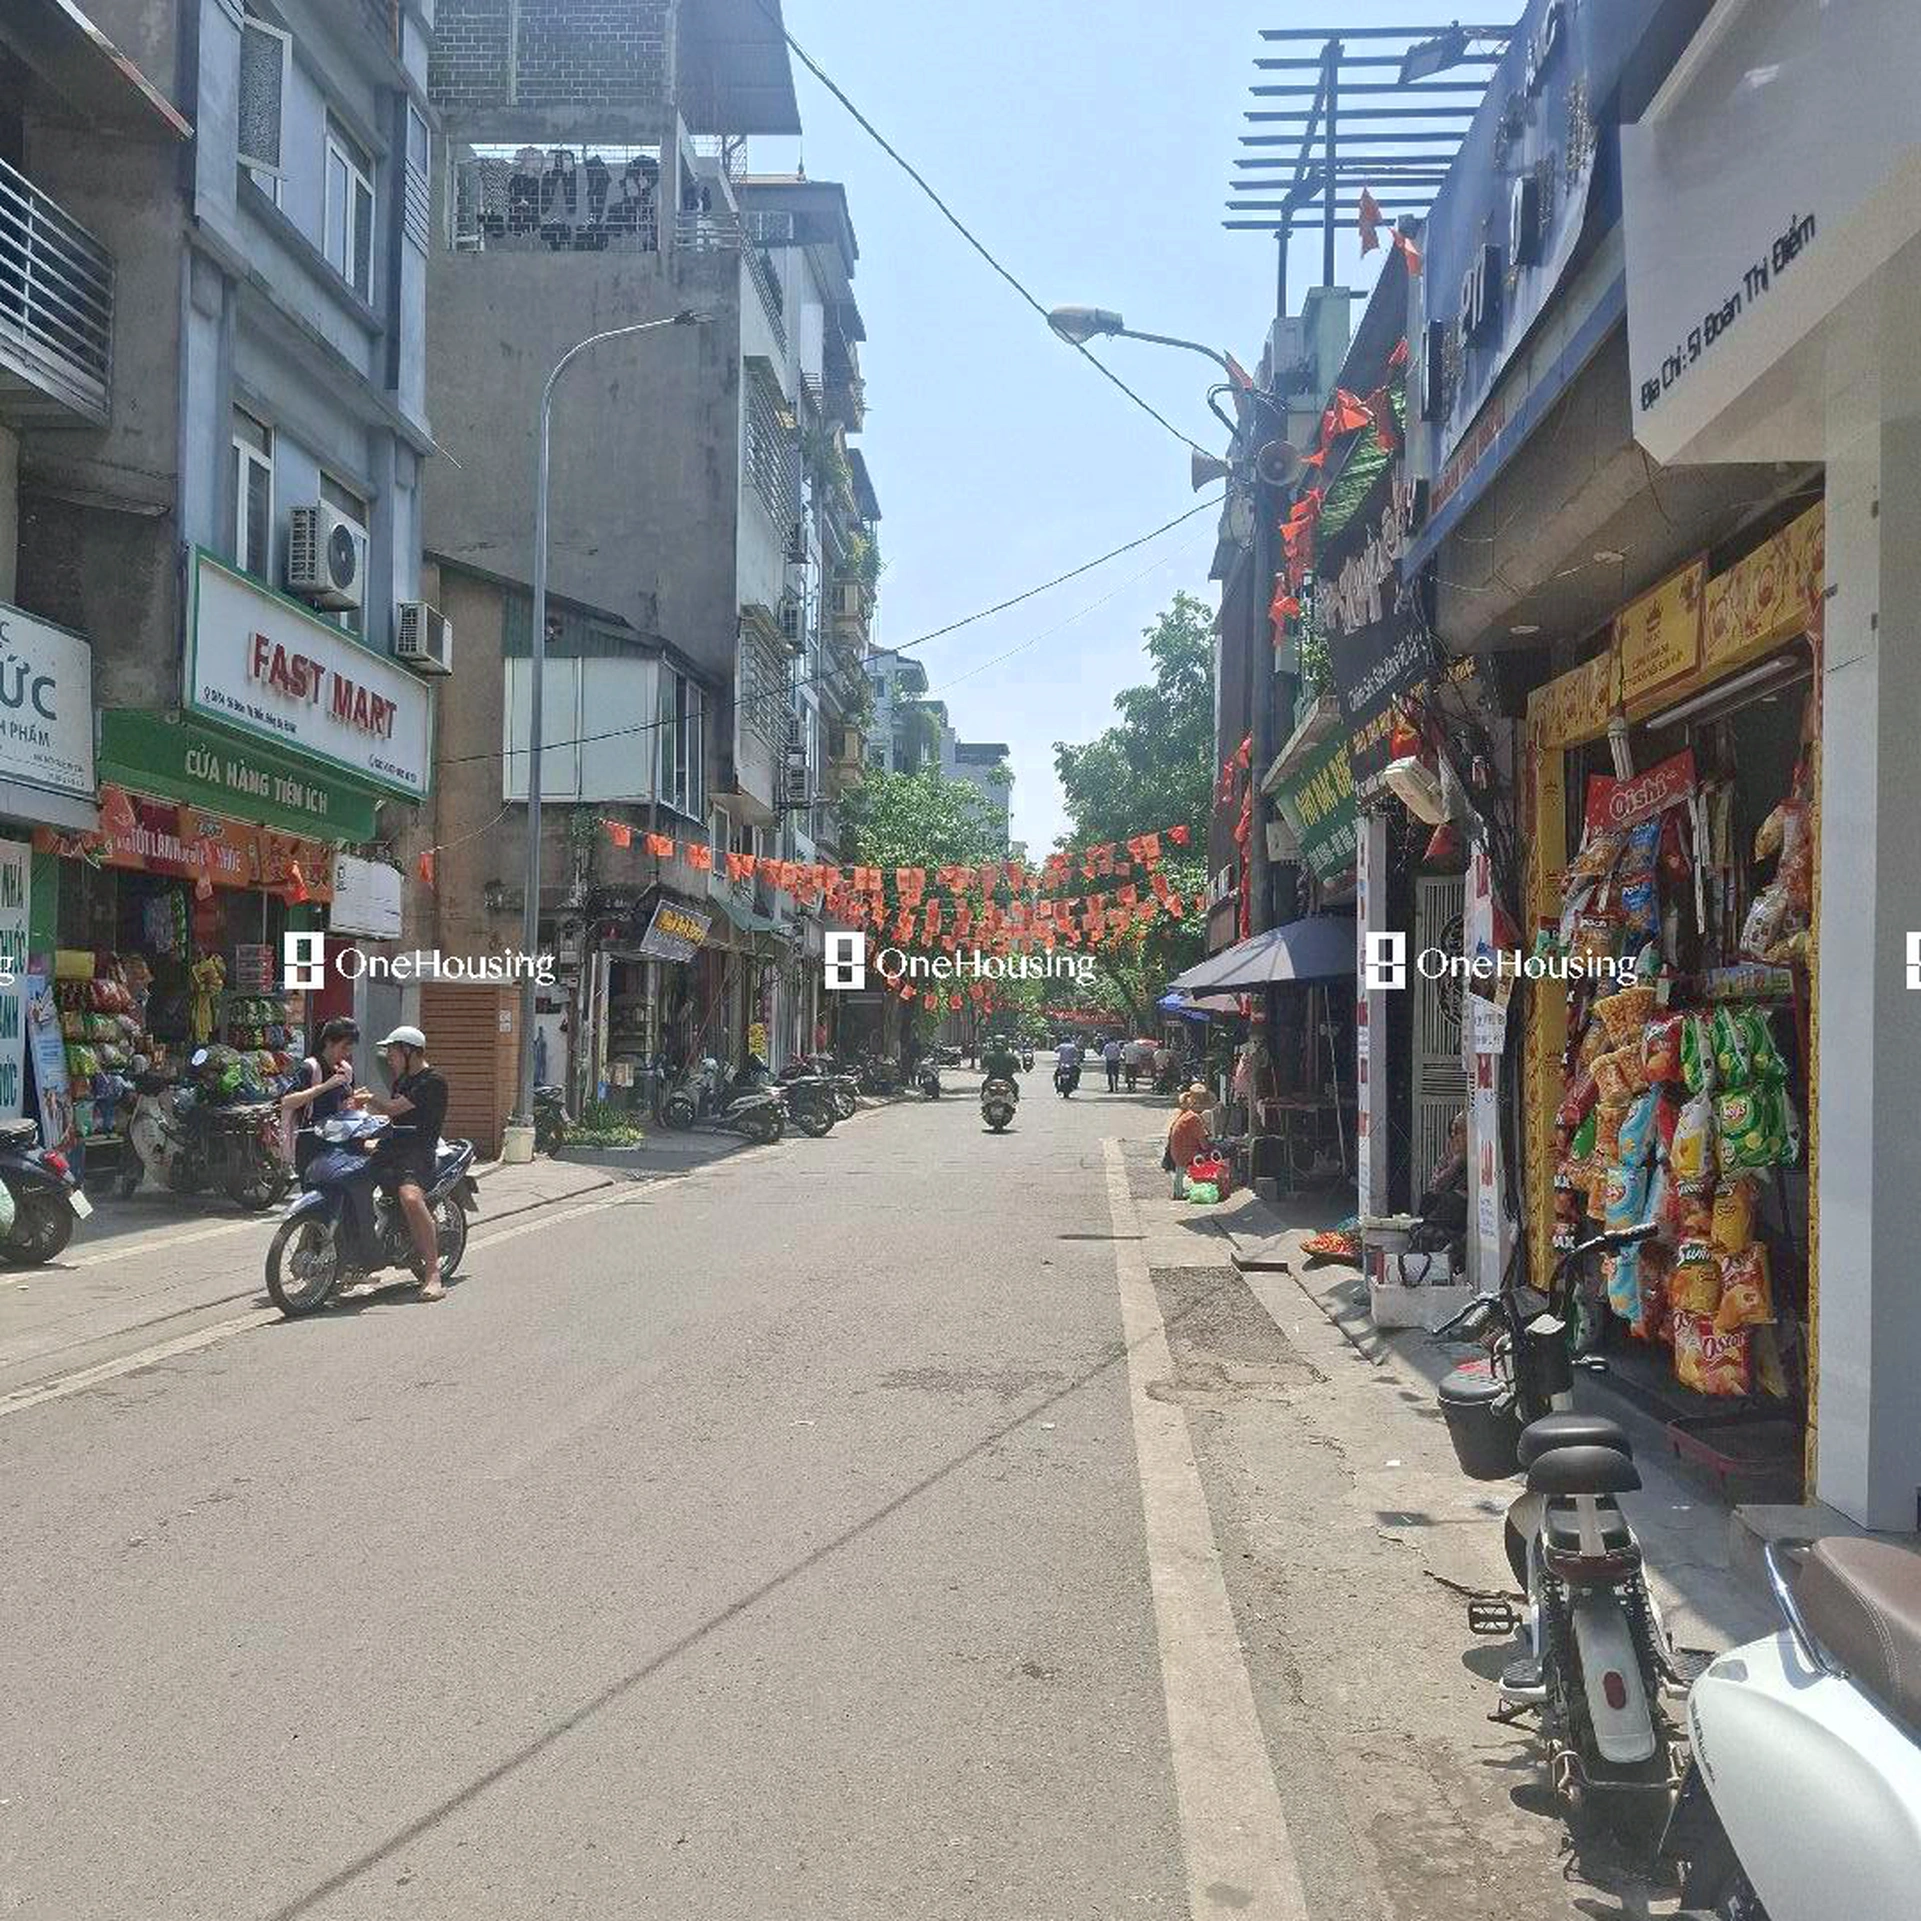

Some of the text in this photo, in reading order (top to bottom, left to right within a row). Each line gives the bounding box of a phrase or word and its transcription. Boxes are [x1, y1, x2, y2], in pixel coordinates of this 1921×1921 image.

[1641, 378, 1660, 411] Địa
[1703, 292, 1742, 346] Đoàn
[1743, 256, 1769, 302] Thị
[1771, 213, 1816, 275] Điểm
[252, 632, 326, 704] FAST
[331, 671, 398, 740] MART
[184, 743, 329, 815] CỬA HÀNG TIỆN ÍCH
